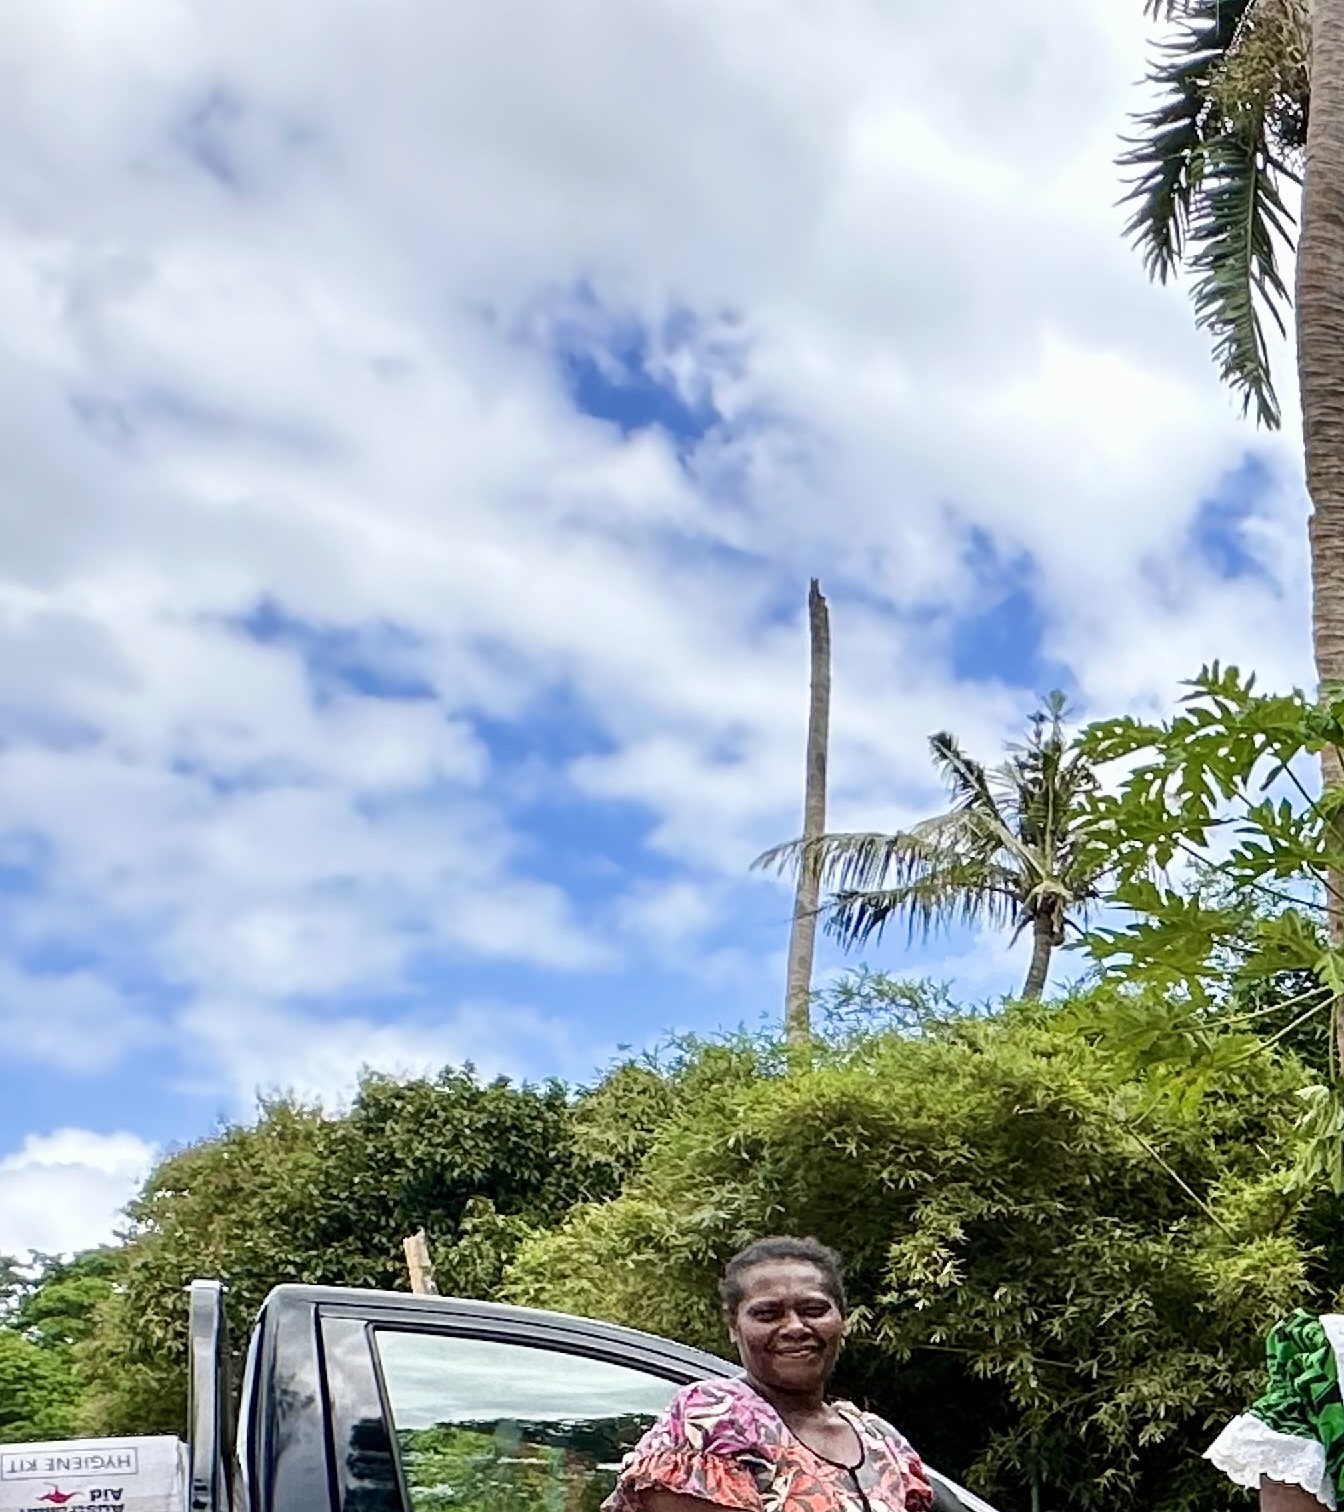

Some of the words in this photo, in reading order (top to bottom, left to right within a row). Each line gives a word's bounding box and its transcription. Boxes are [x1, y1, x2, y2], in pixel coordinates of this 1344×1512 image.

[7, 1458, 38, 1473] KIT
[46, 1454, 131, 1472] HYGIENE
[89, 1487, 124, 1501] Aid
